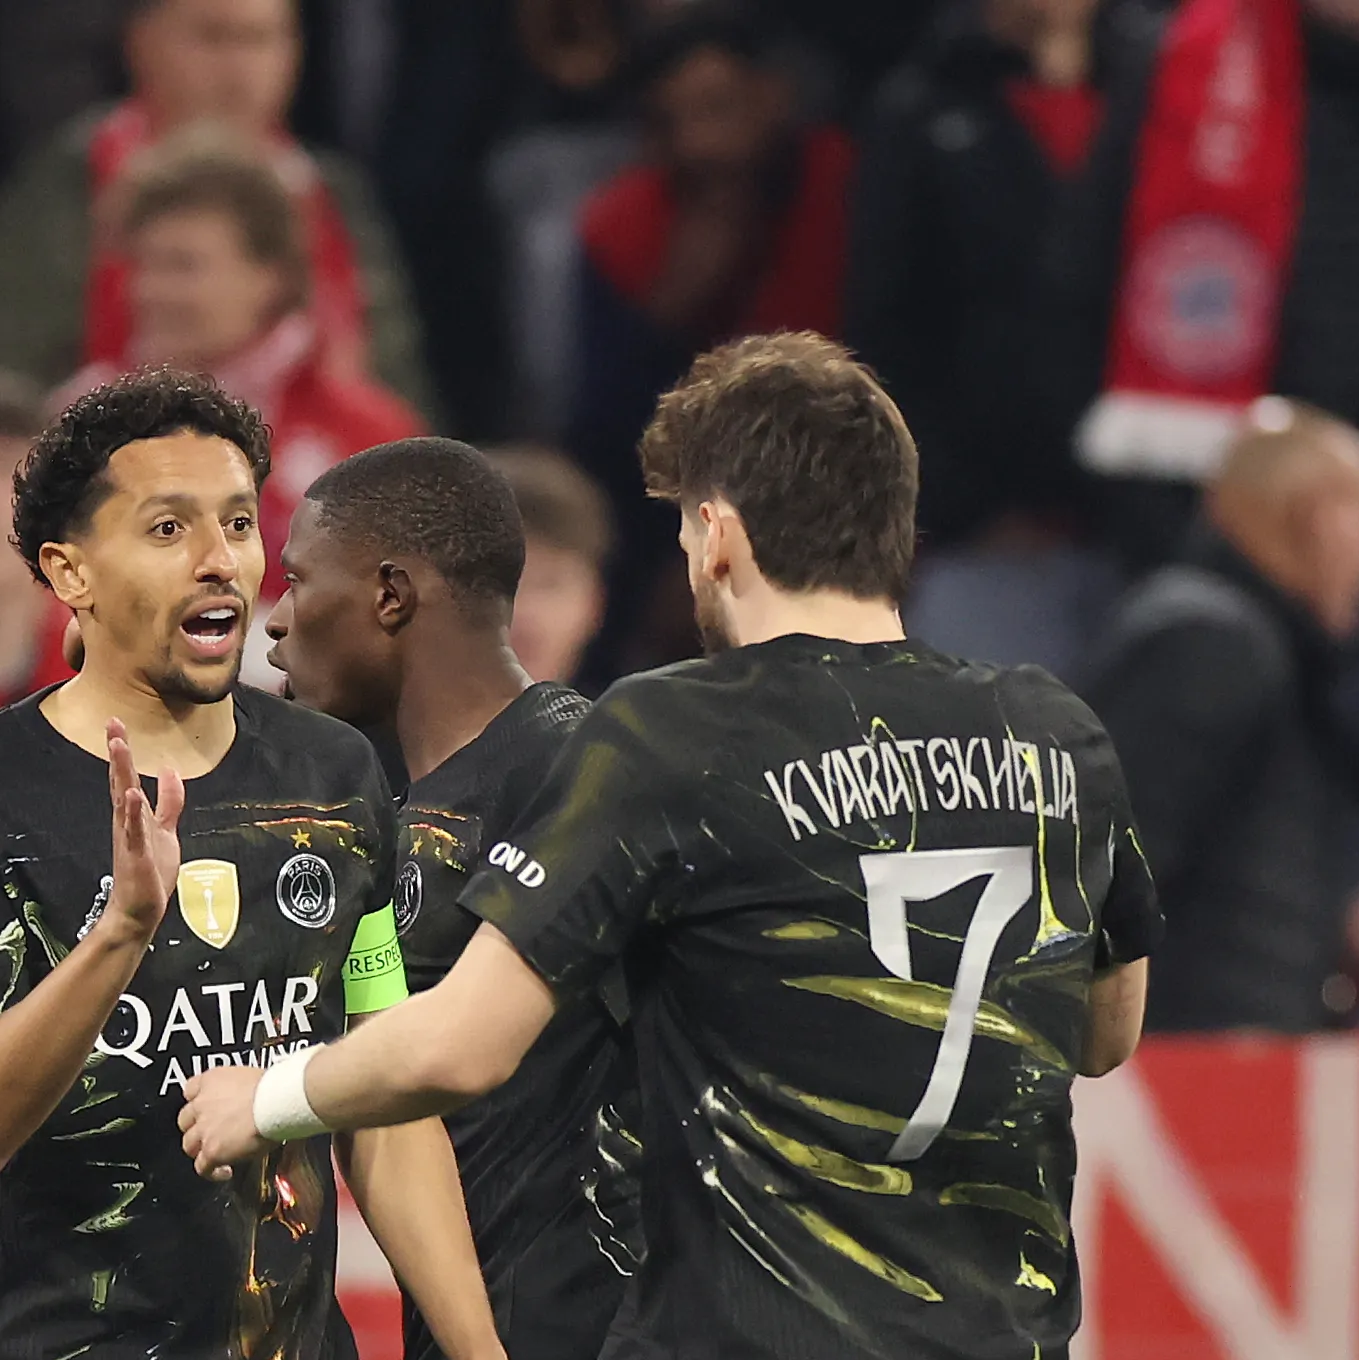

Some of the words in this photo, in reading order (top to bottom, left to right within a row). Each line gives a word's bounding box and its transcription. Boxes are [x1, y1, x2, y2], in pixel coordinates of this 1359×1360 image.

[763, 737, 1078, 842] KVARATSKHELIA
[287, 860, 323, 879] PARIS
[94, 976, 318, 1069] QATAR
[858, 845, 1034, 1163] 7
